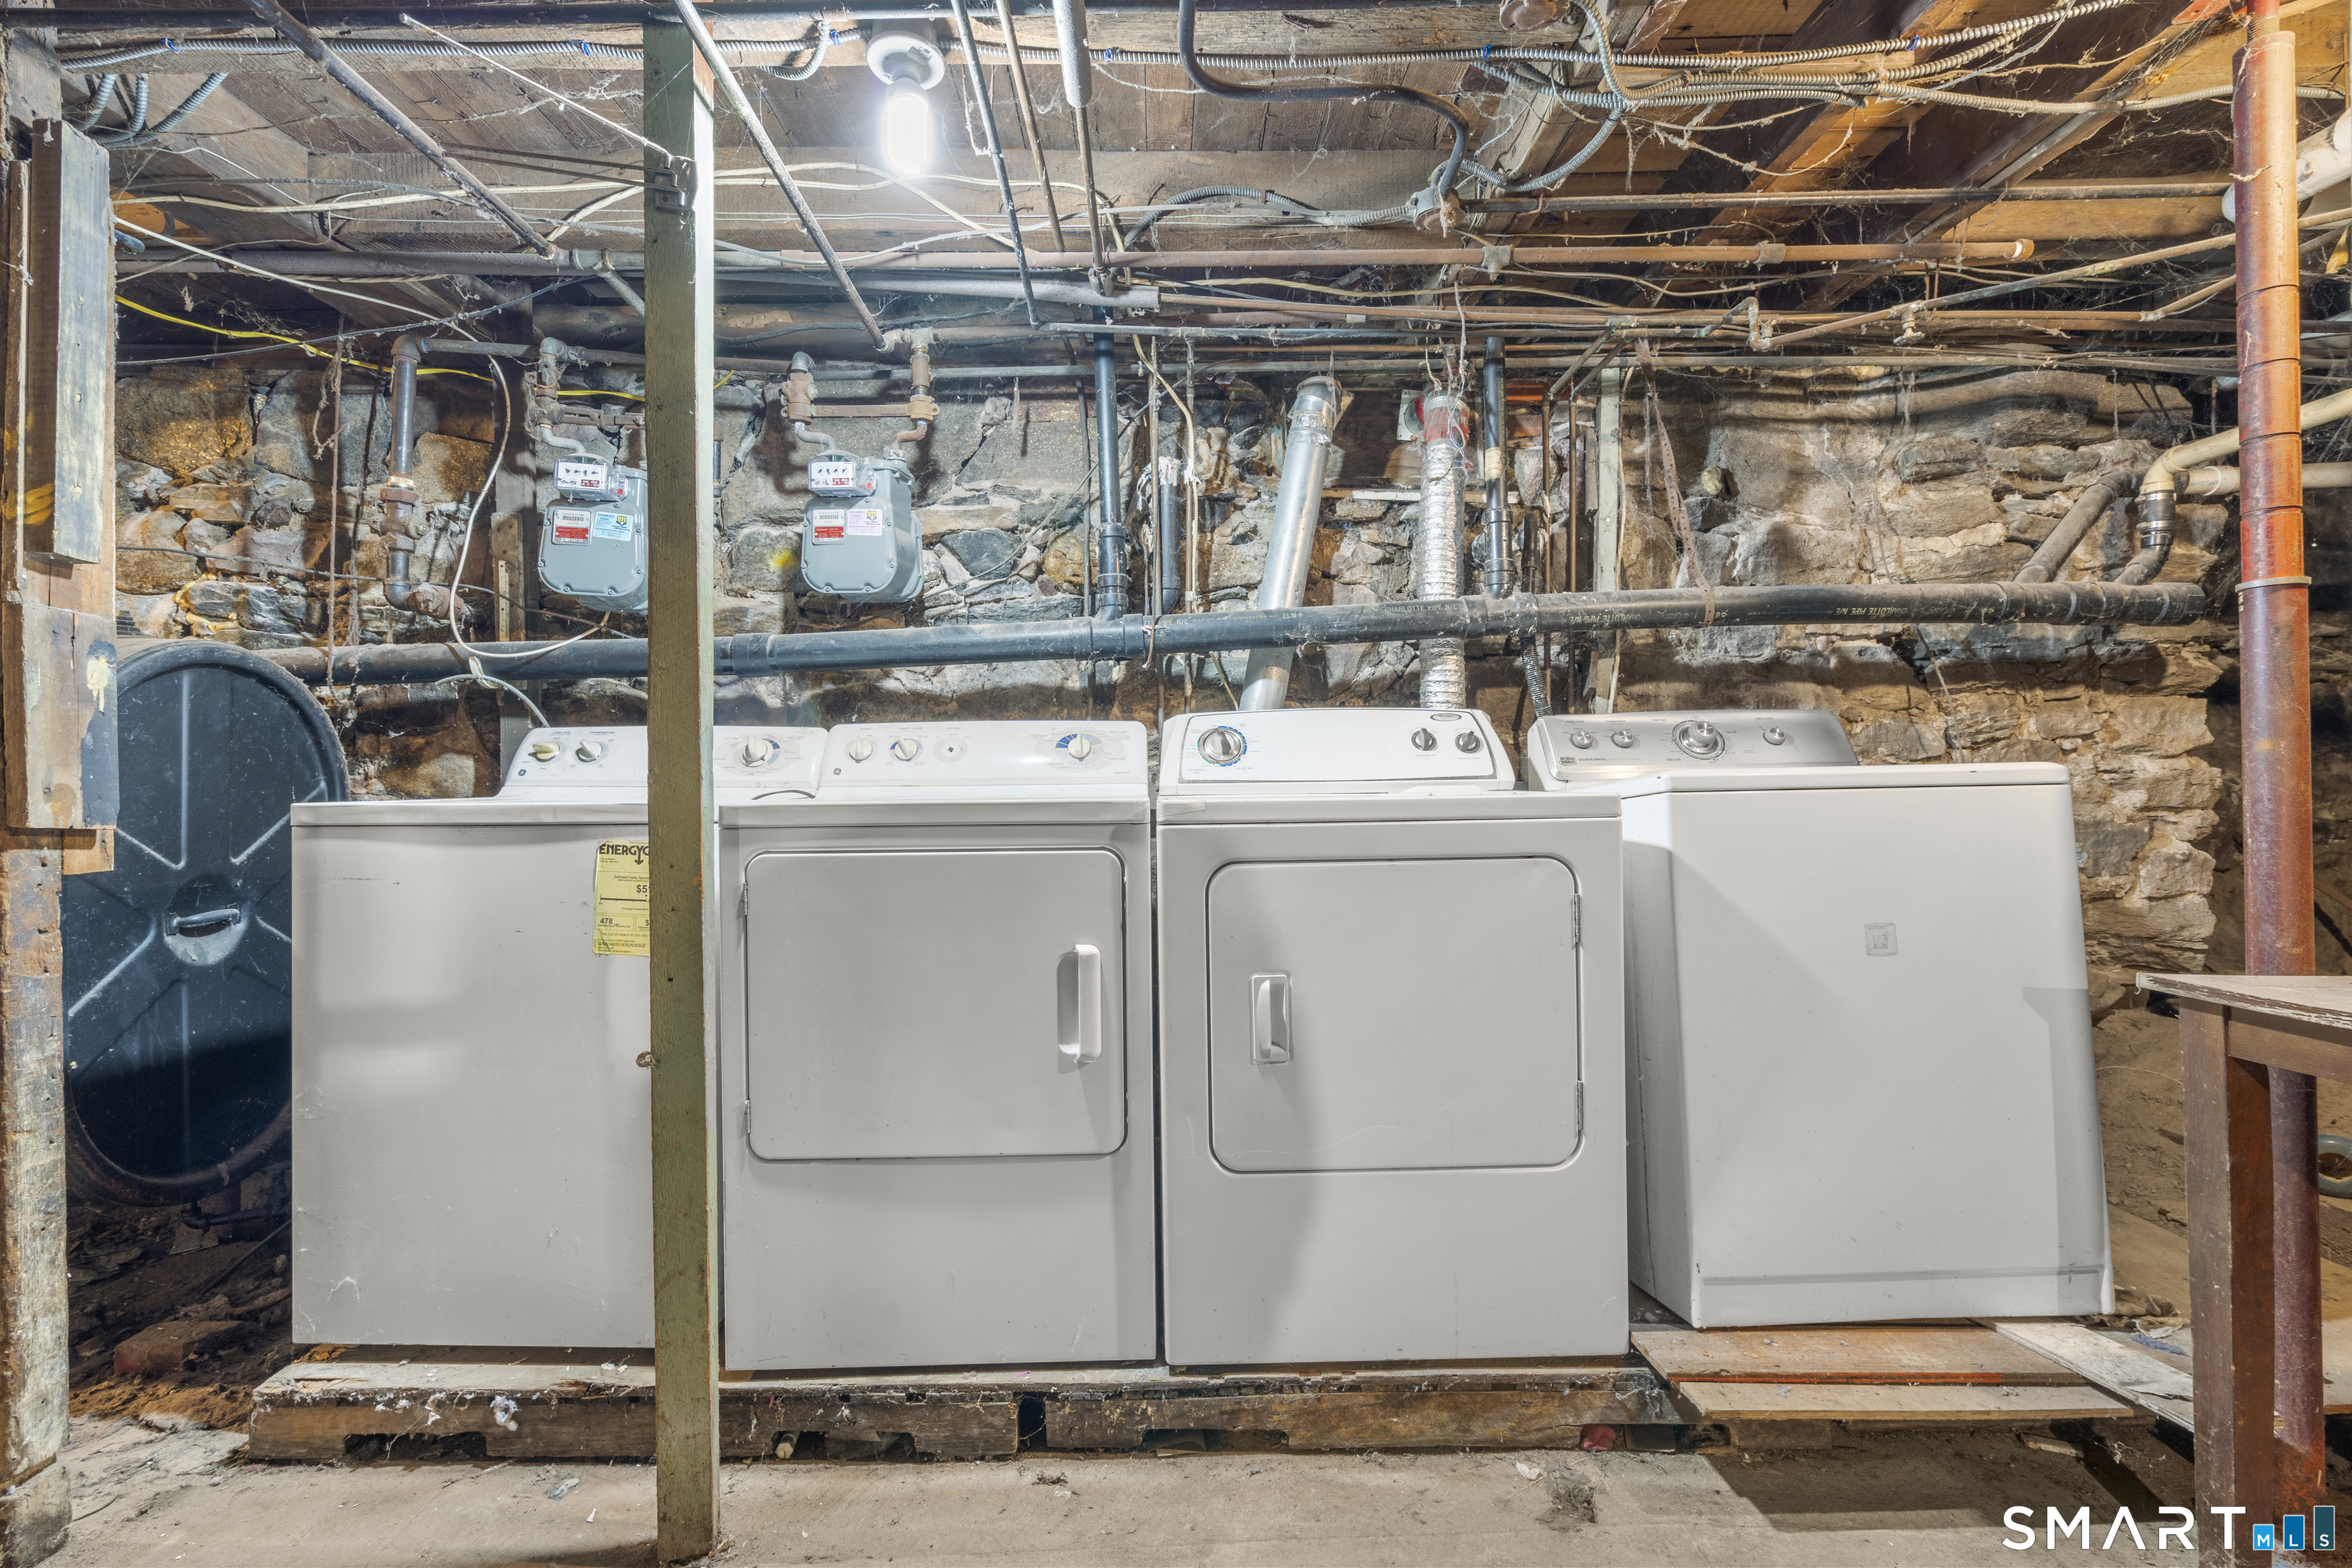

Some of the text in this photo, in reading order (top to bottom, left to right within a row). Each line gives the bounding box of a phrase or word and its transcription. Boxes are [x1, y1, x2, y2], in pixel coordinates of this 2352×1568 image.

[1385, 605, 1424, 613] CHARLOTTE
[1851, 607, 1866, 616] PIPE
[1868, 606, 1908, 616] CHARLOTTE
[1584, 615, 1599, 623] PIPE
